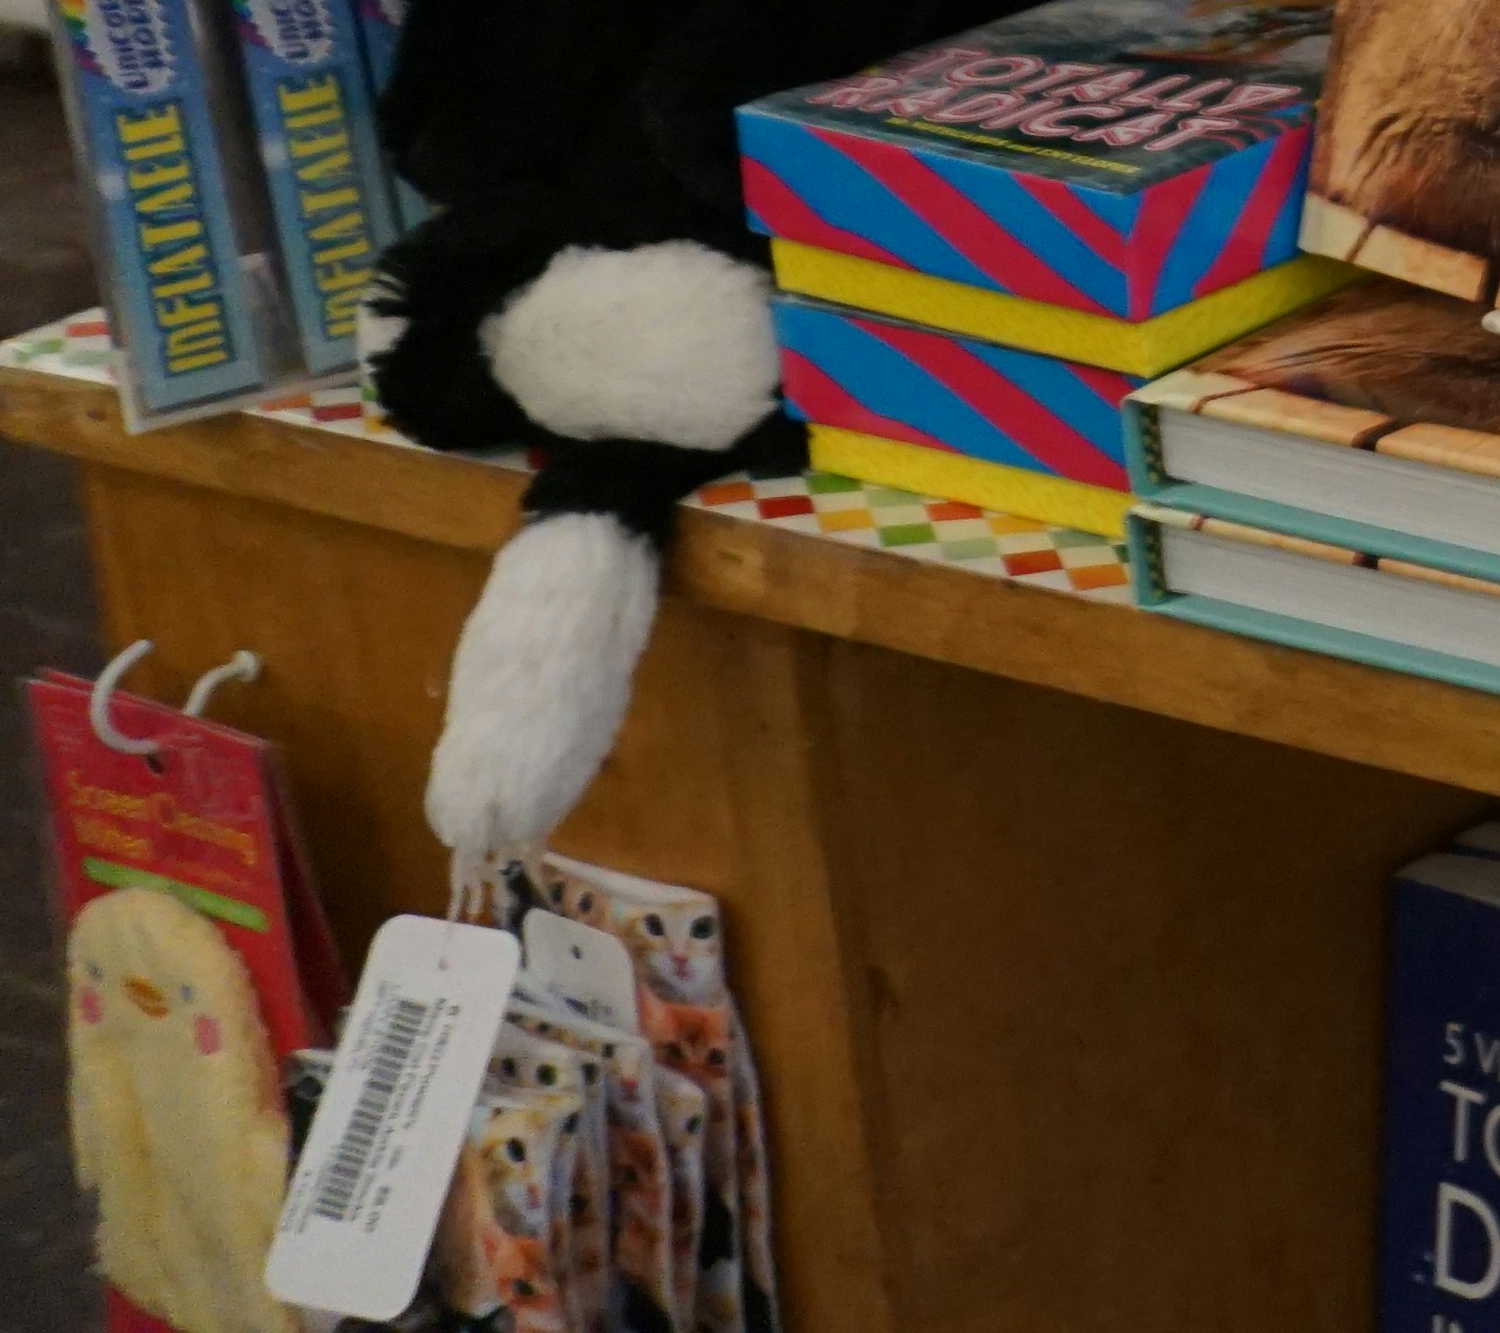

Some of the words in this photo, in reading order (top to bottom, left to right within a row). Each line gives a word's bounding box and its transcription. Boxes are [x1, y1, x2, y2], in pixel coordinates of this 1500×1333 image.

[805, 75, 1240, 152] RADICAT
[896, 47, 1302, 118] TOTALLY
[117, 103, 230, 374] INFLATABLE
[1442, 1022, 1466, 1065] 5
